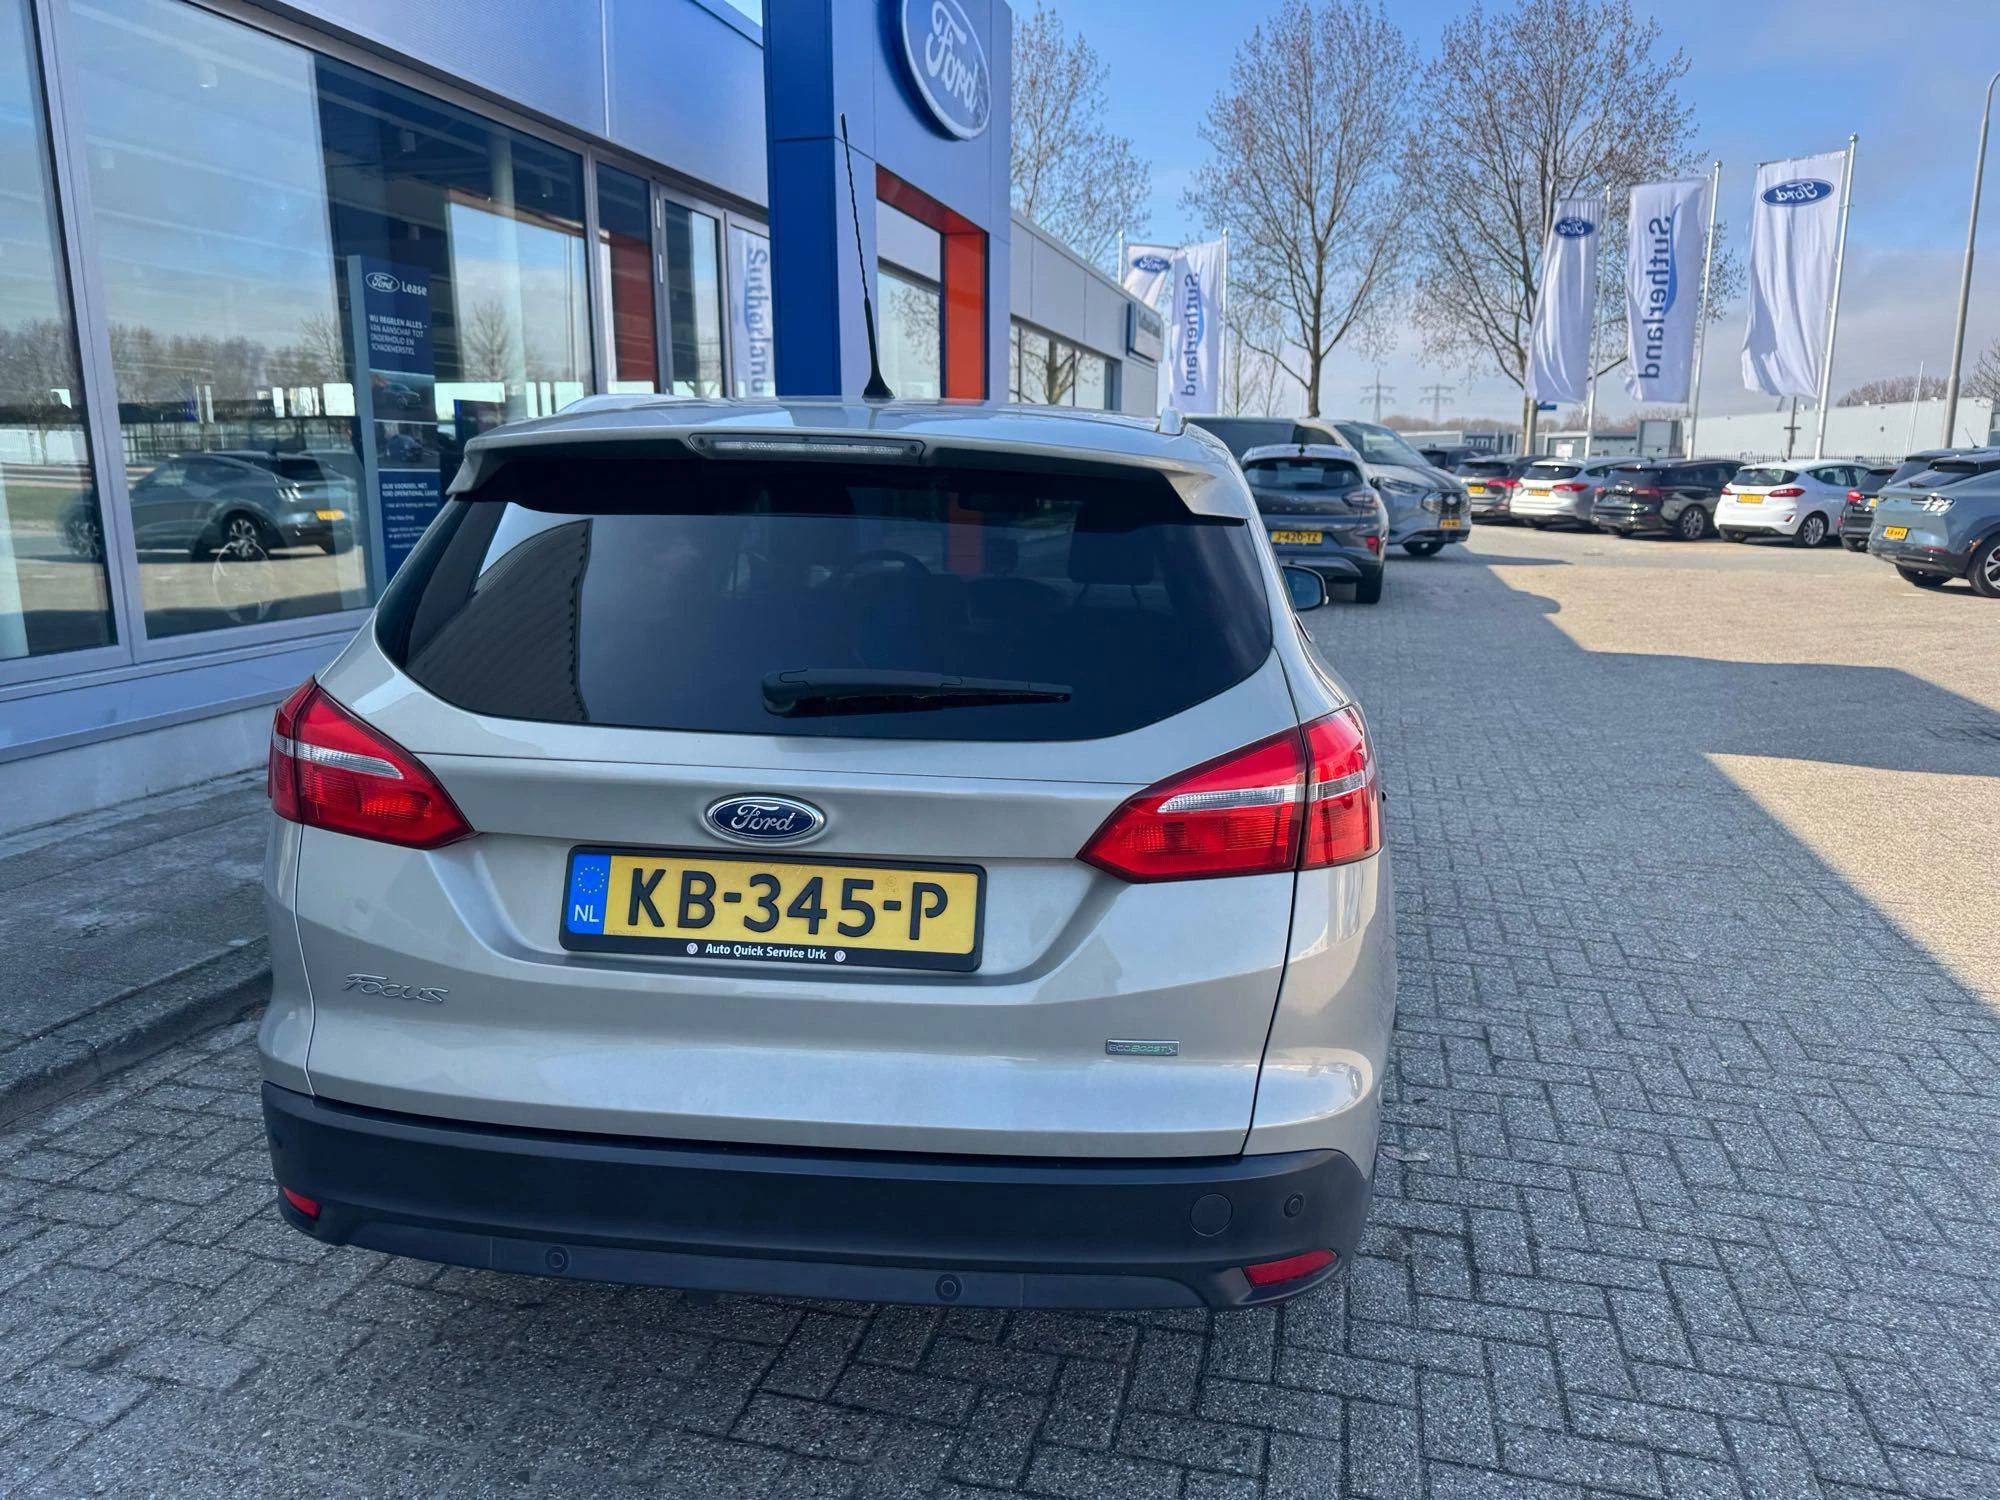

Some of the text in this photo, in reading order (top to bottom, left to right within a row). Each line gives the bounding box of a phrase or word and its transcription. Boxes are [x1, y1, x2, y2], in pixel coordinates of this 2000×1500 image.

[925, 0, 979, 114] Ford
[371, 274, 428, 296] Ford Lease
[730, 804, 796, 831] Ford
[573, 904, 600, 923] NL
[628, 868, 949, 940] KB-345-P
[705, 943, 827, 960] Auto Quick Service Urk
